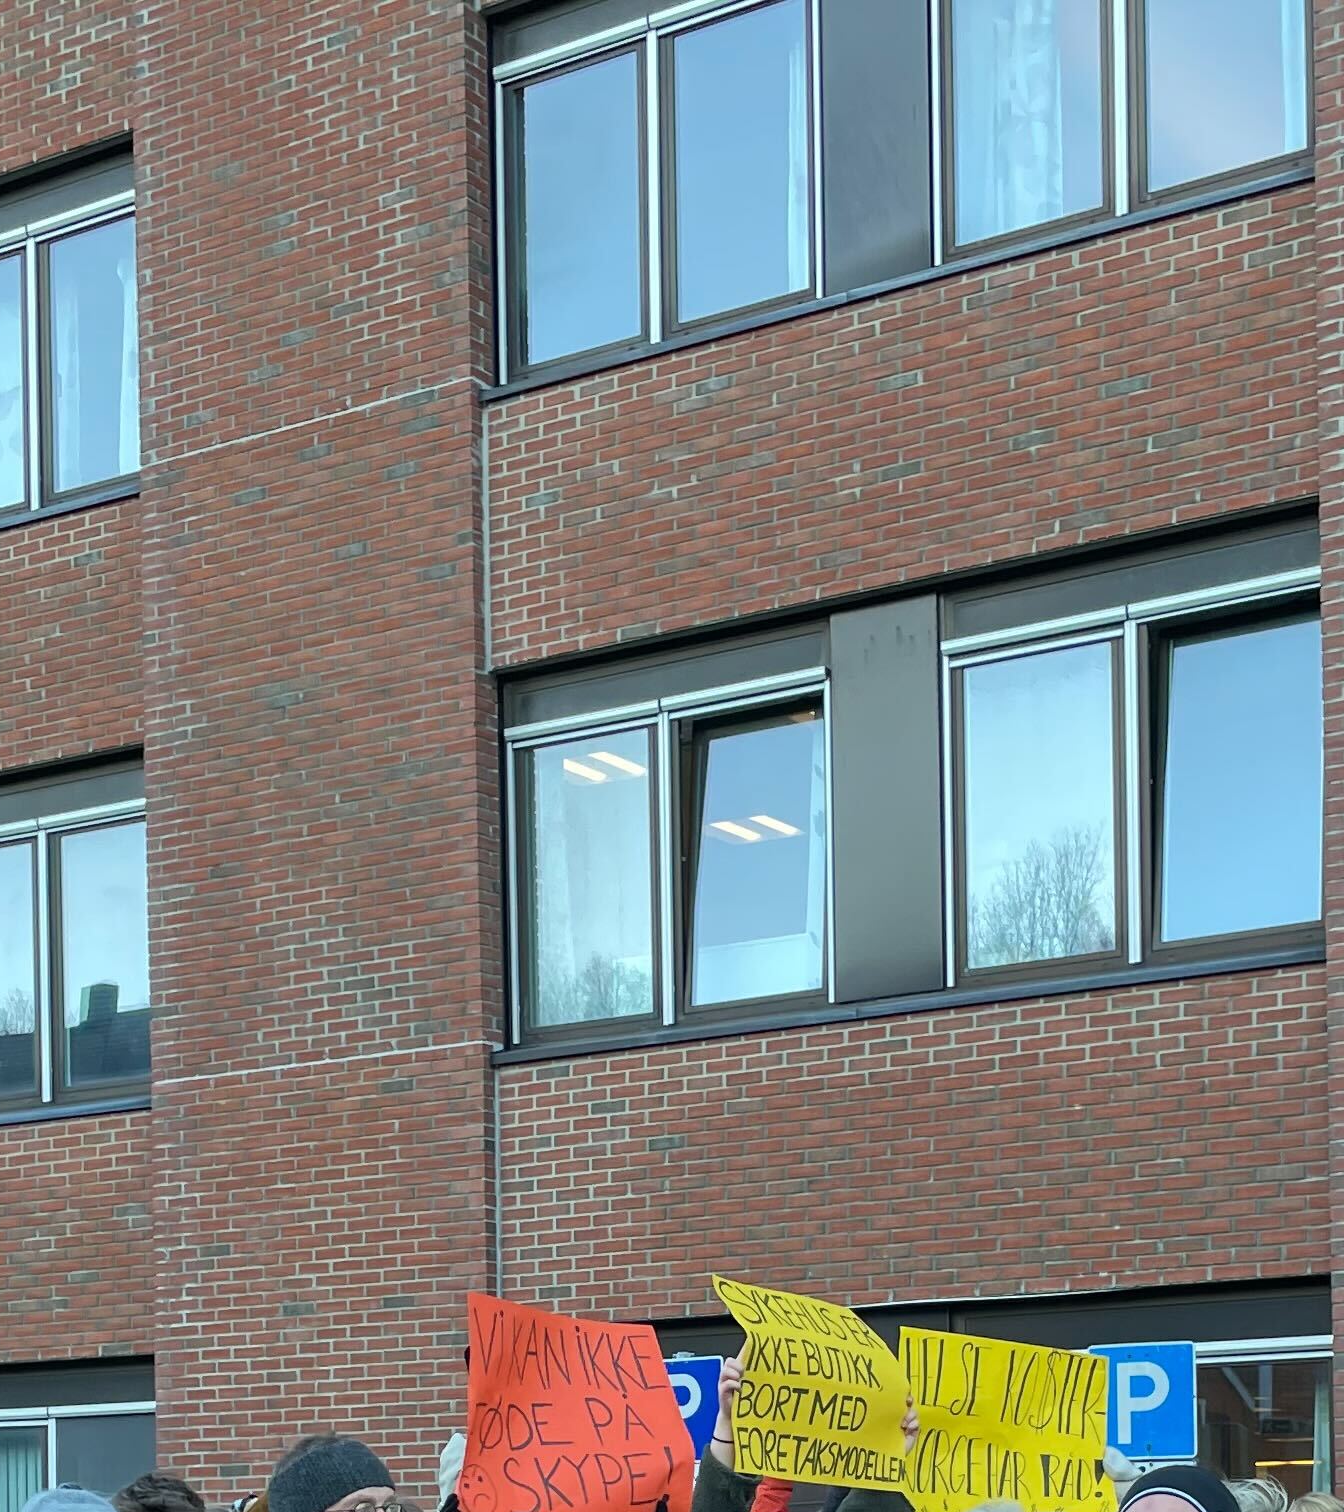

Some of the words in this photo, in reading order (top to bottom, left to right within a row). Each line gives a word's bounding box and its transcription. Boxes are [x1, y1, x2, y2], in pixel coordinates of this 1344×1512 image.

[718, 1280, 848, 1341] SYKEHUS
[839, 1314, 885, 1350] ER
[507, 1315, 572, 1390] KAN
[745, 1330, 801, 1375] IKKE
[905, 1337, 993, 1417] HELSE
[585, 1393, 655, 1446] PÅ
[736, 1379, 810, 1422] BORT
[808, 1389, 868, 1432] MED
[1117, 1361, 1170, 1445] P
[736, 1427, 906, 1484] FORETAKSMODELLEN
[987, 1442, 1032, 1501] HAR
[1040, 1452, 1104, 1501] RÅD!
